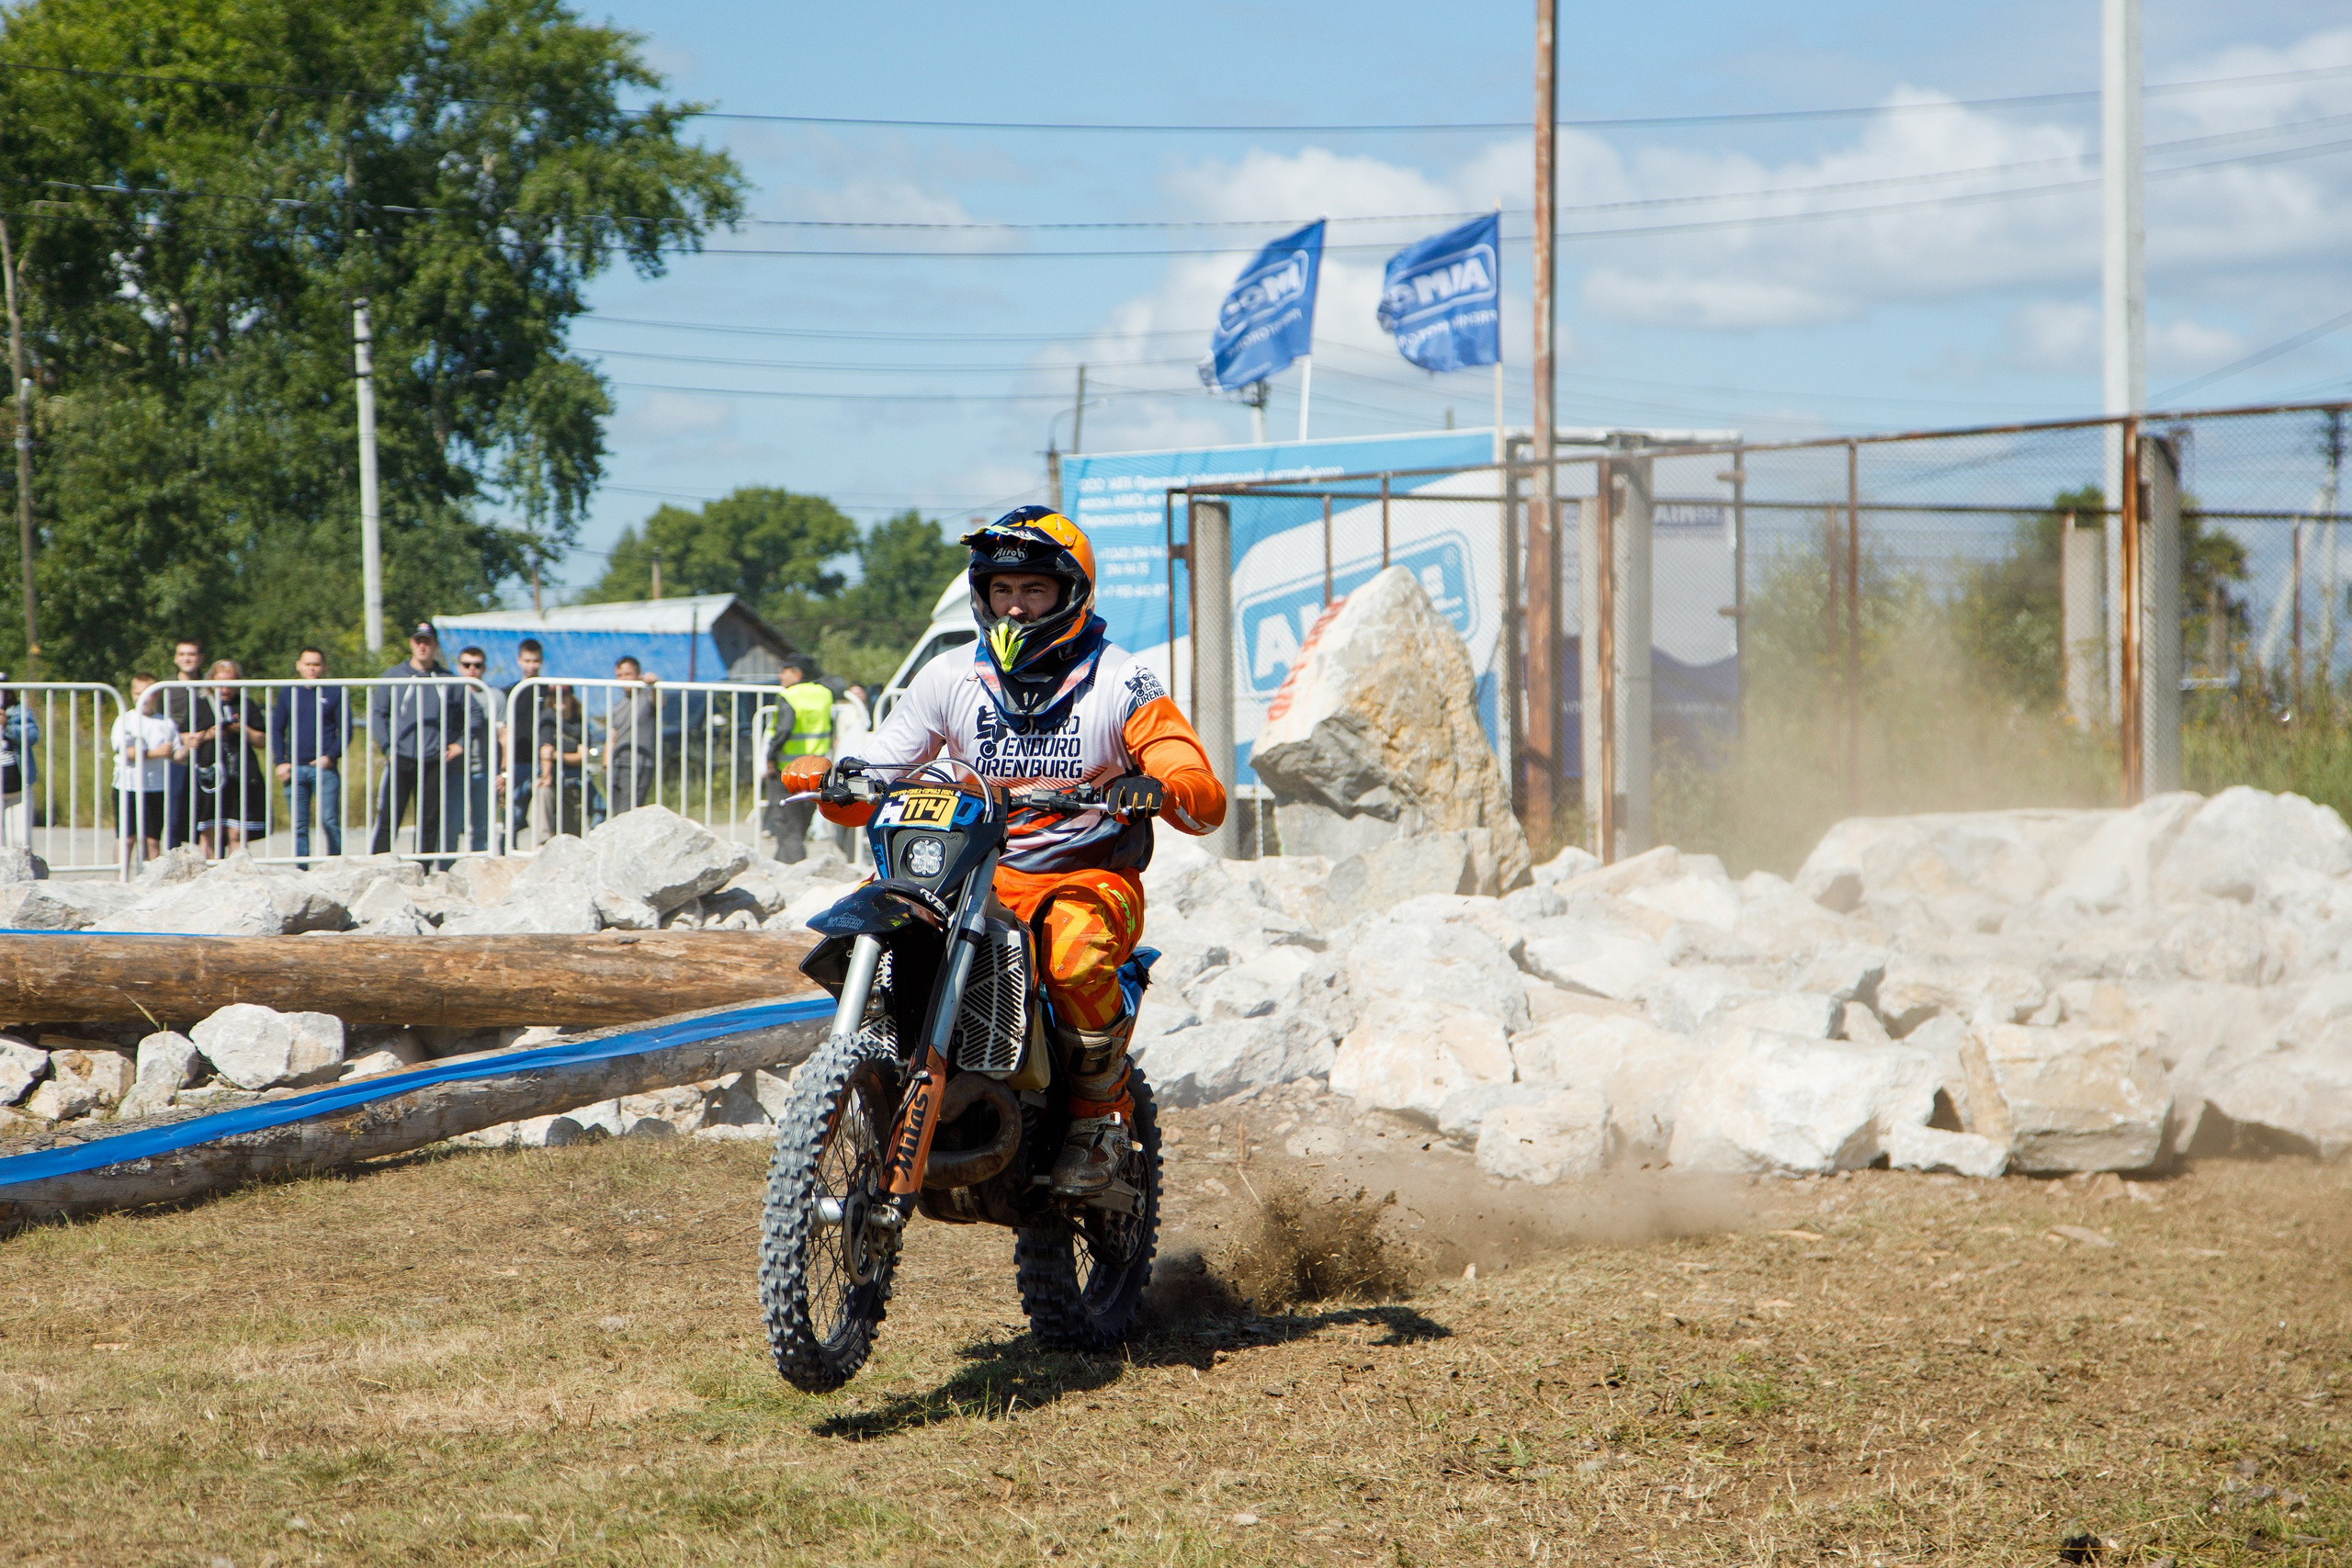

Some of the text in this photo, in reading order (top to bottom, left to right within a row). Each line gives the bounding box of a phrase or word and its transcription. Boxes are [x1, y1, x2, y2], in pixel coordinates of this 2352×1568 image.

[993, 547, 1025, 558] Airoh
[1001, 737, 1081, 757] ENDURO
[975, 756, 1083, 779] ORENBURG
[904, 798, 947, 819] 114
[898, 1093, 929, 1182] Mitas
